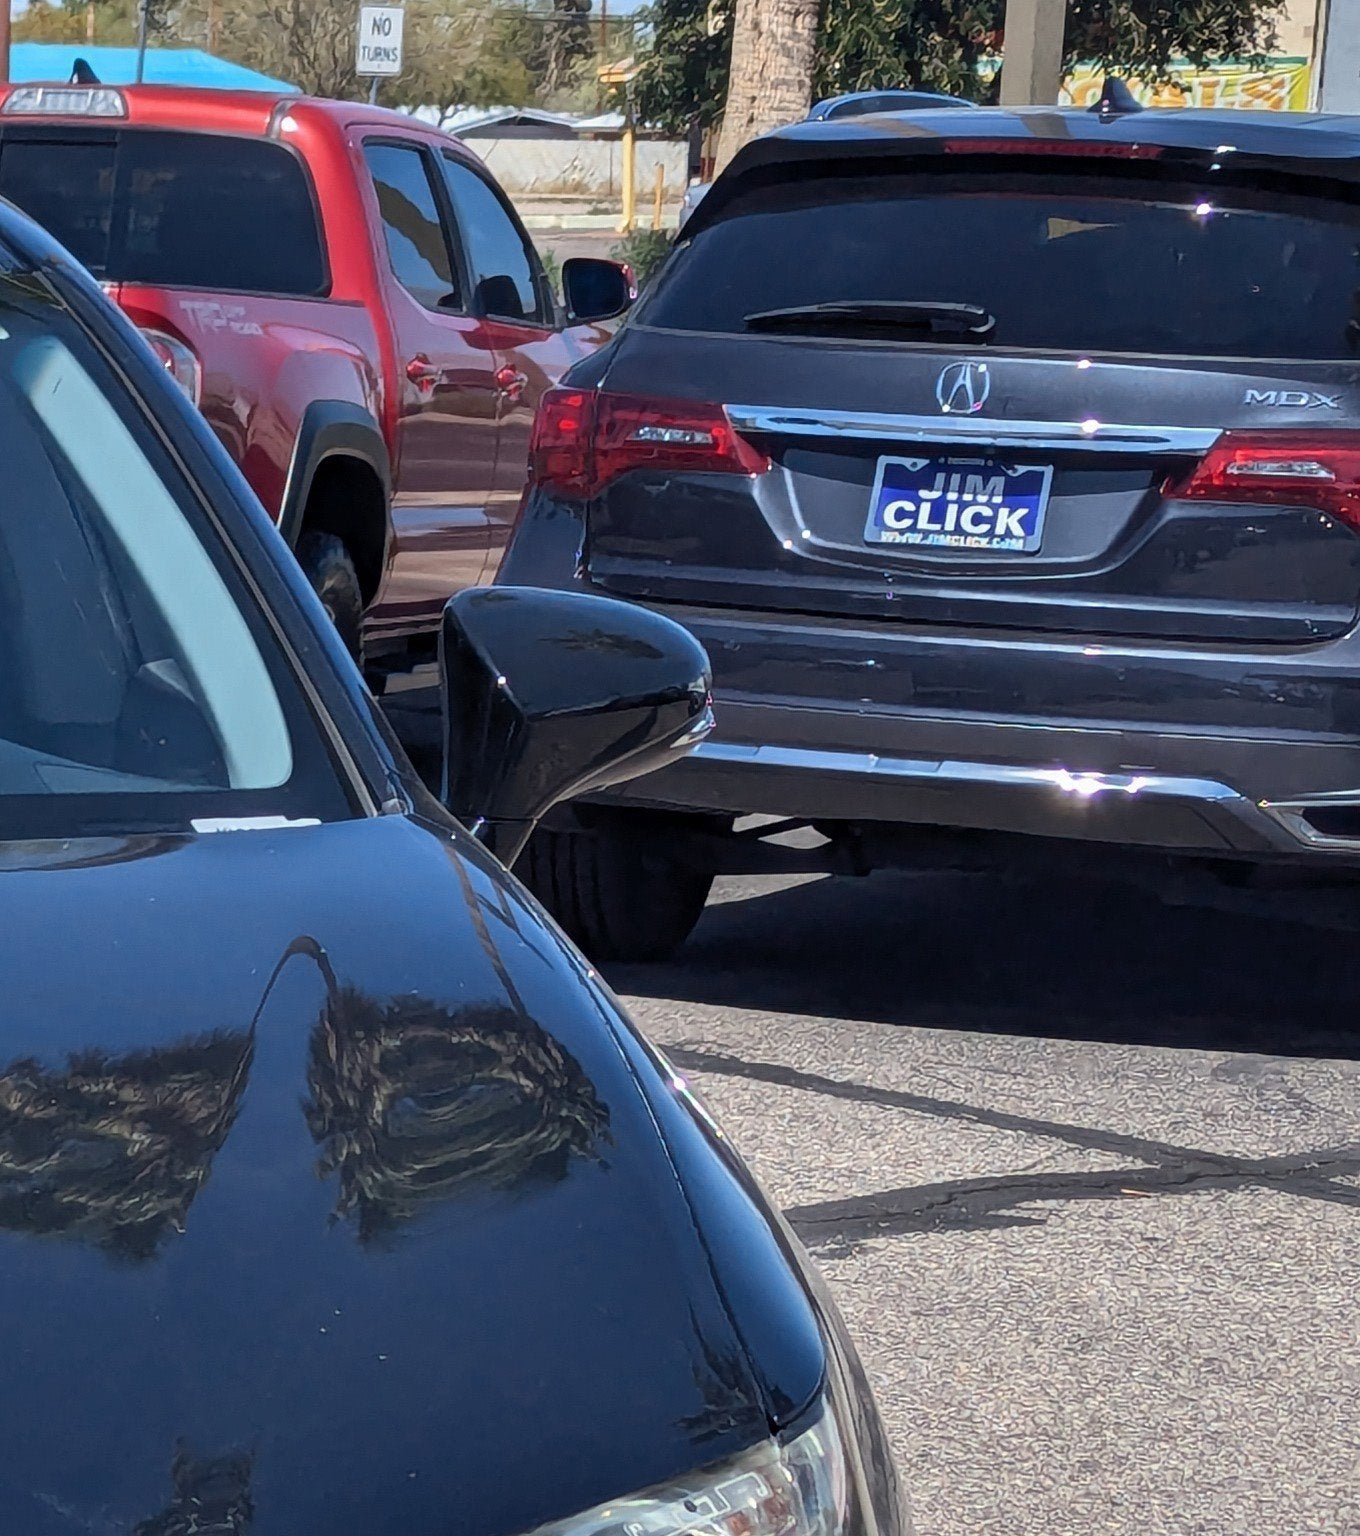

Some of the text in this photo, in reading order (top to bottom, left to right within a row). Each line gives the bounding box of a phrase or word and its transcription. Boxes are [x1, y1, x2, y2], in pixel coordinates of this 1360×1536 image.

[371, 16, 392, 37] NO
[361, 45, 399, 63] TURNS
[1244, 389, 1343, 410] MDX
[918, 472, 1006, 504] JIM
[882, 500, 1030, 537] CLICK
